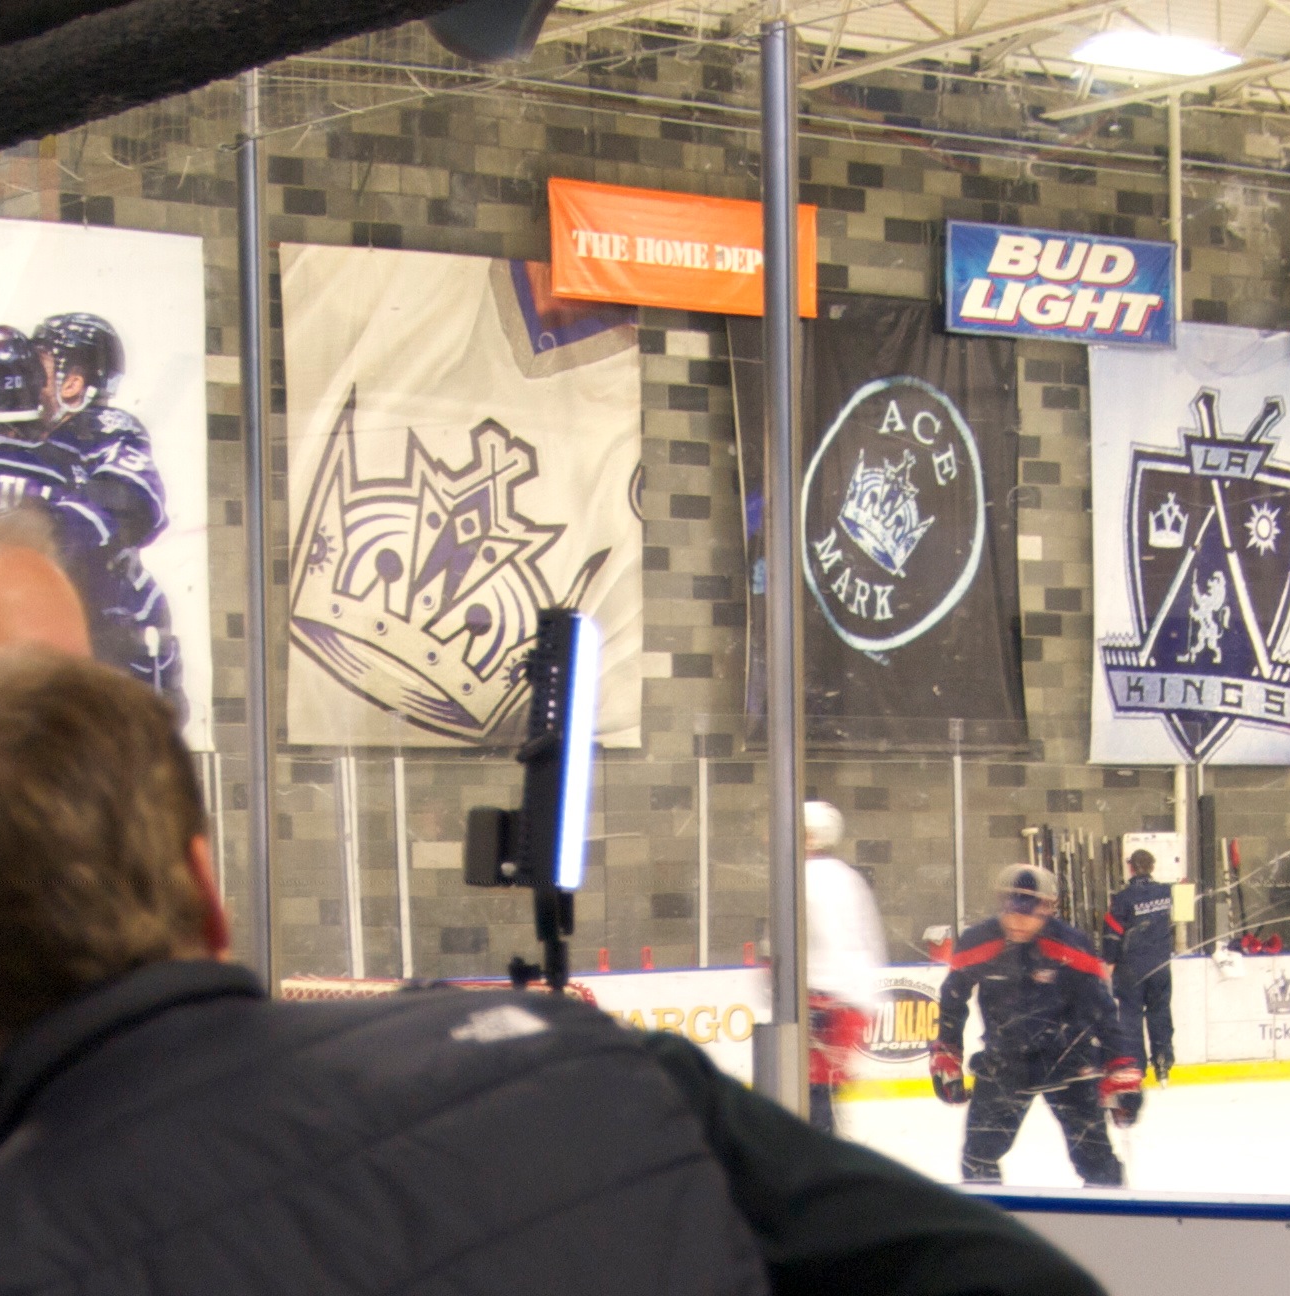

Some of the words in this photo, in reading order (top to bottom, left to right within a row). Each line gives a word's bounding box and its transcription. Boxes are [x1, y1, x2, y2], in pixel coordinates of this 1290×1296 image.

[572, 230, 629, 262] THE
[635, 237, 709, 270] HOME
[714, 244, 764, 275] DEP
[987, 233, 1135, 286] BUD
[960, 278, 1162, 336] LIGHT
[878, 400, 959, 486] ACE
[1201, 450, 1250, 476] LA
[814, 528, 895, 621] MARK
[1127, 676, 1287, 717] KINGS
[609, 1003, 756, 1044] ARGO
[895, 1000, 940, 1041] KLAC
[870, 1041, 928, 1051] SPORTS
